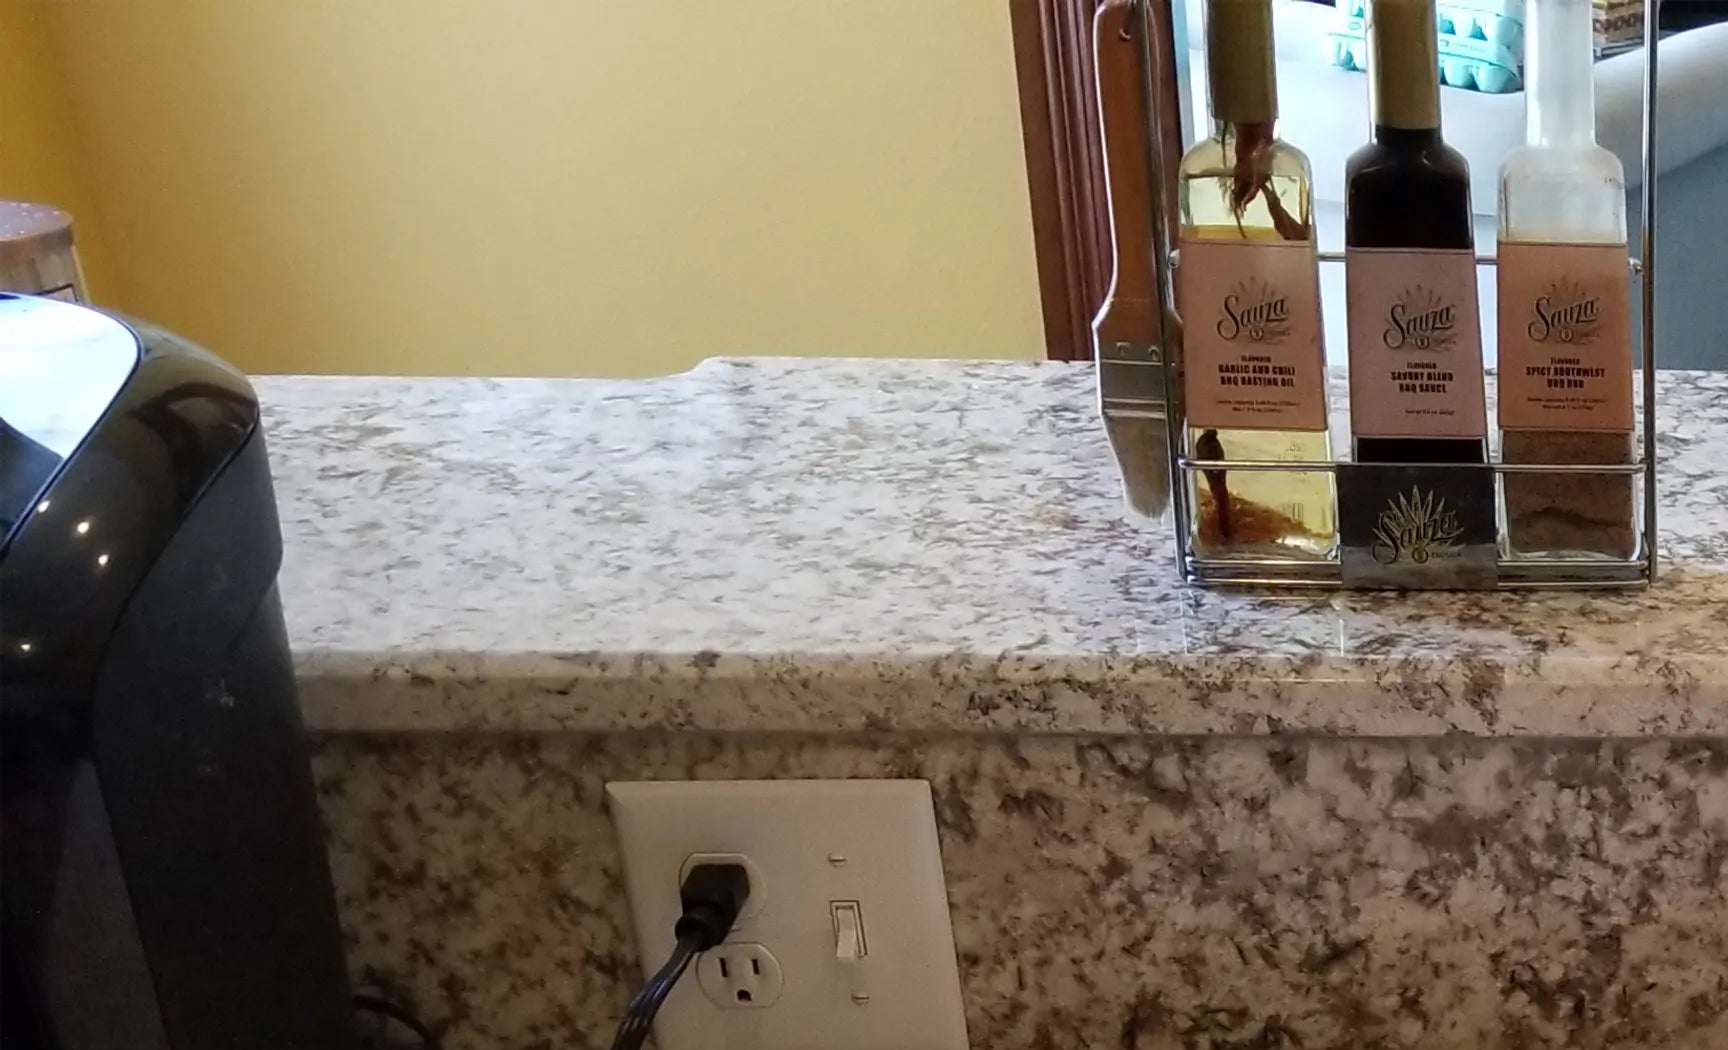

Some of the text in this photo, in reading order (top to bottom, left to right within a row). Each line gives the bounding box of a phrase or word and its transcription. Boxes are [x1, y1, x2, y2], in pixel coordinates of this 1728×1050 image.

[1216, 294, 1290, 341] Sauza
[1527, 294, 1599, 342] Sauza
[1382, 302, 1455, 349] Sauza
[1218, 364, 1296, 376] GARLIC AND CHILI
[1526, 366, 1606, 378] SPICY SOUTHWEST
[1220, 376, 1295, 388] BBQ BASTING OIL
[1391, 371, 1454, 382] SAVORY BLEND
[1399, 383, 1447, 394] BBQ SAUCE
[1546, 378, 1585, 389] BBQ RUB
[1371, 510, 1460, 565] Sauza
